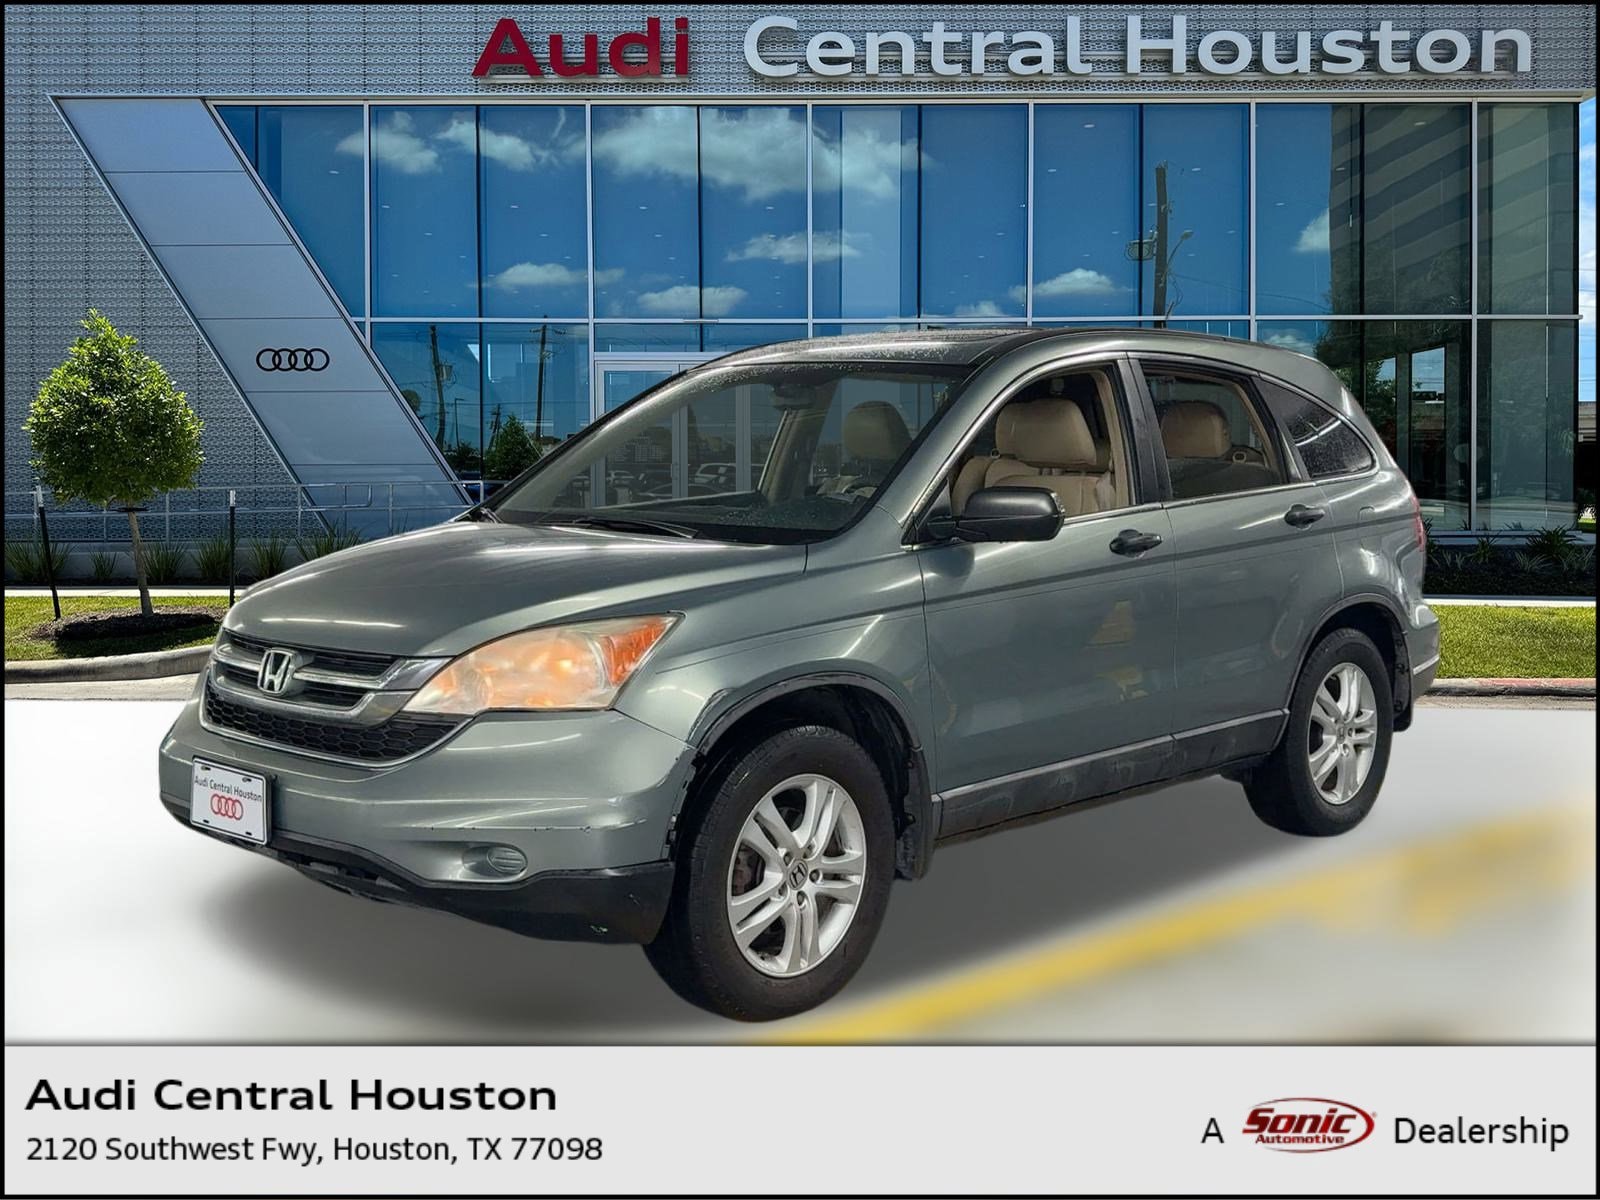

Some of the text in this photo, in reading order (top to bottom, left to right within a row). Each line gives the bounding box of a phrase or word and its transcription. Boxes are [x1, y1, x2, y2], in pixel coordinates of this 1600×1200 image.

[472, 15, 1533, 78] Audi Central Houston
[194, 775, 263, 802] Audi Central Houston
